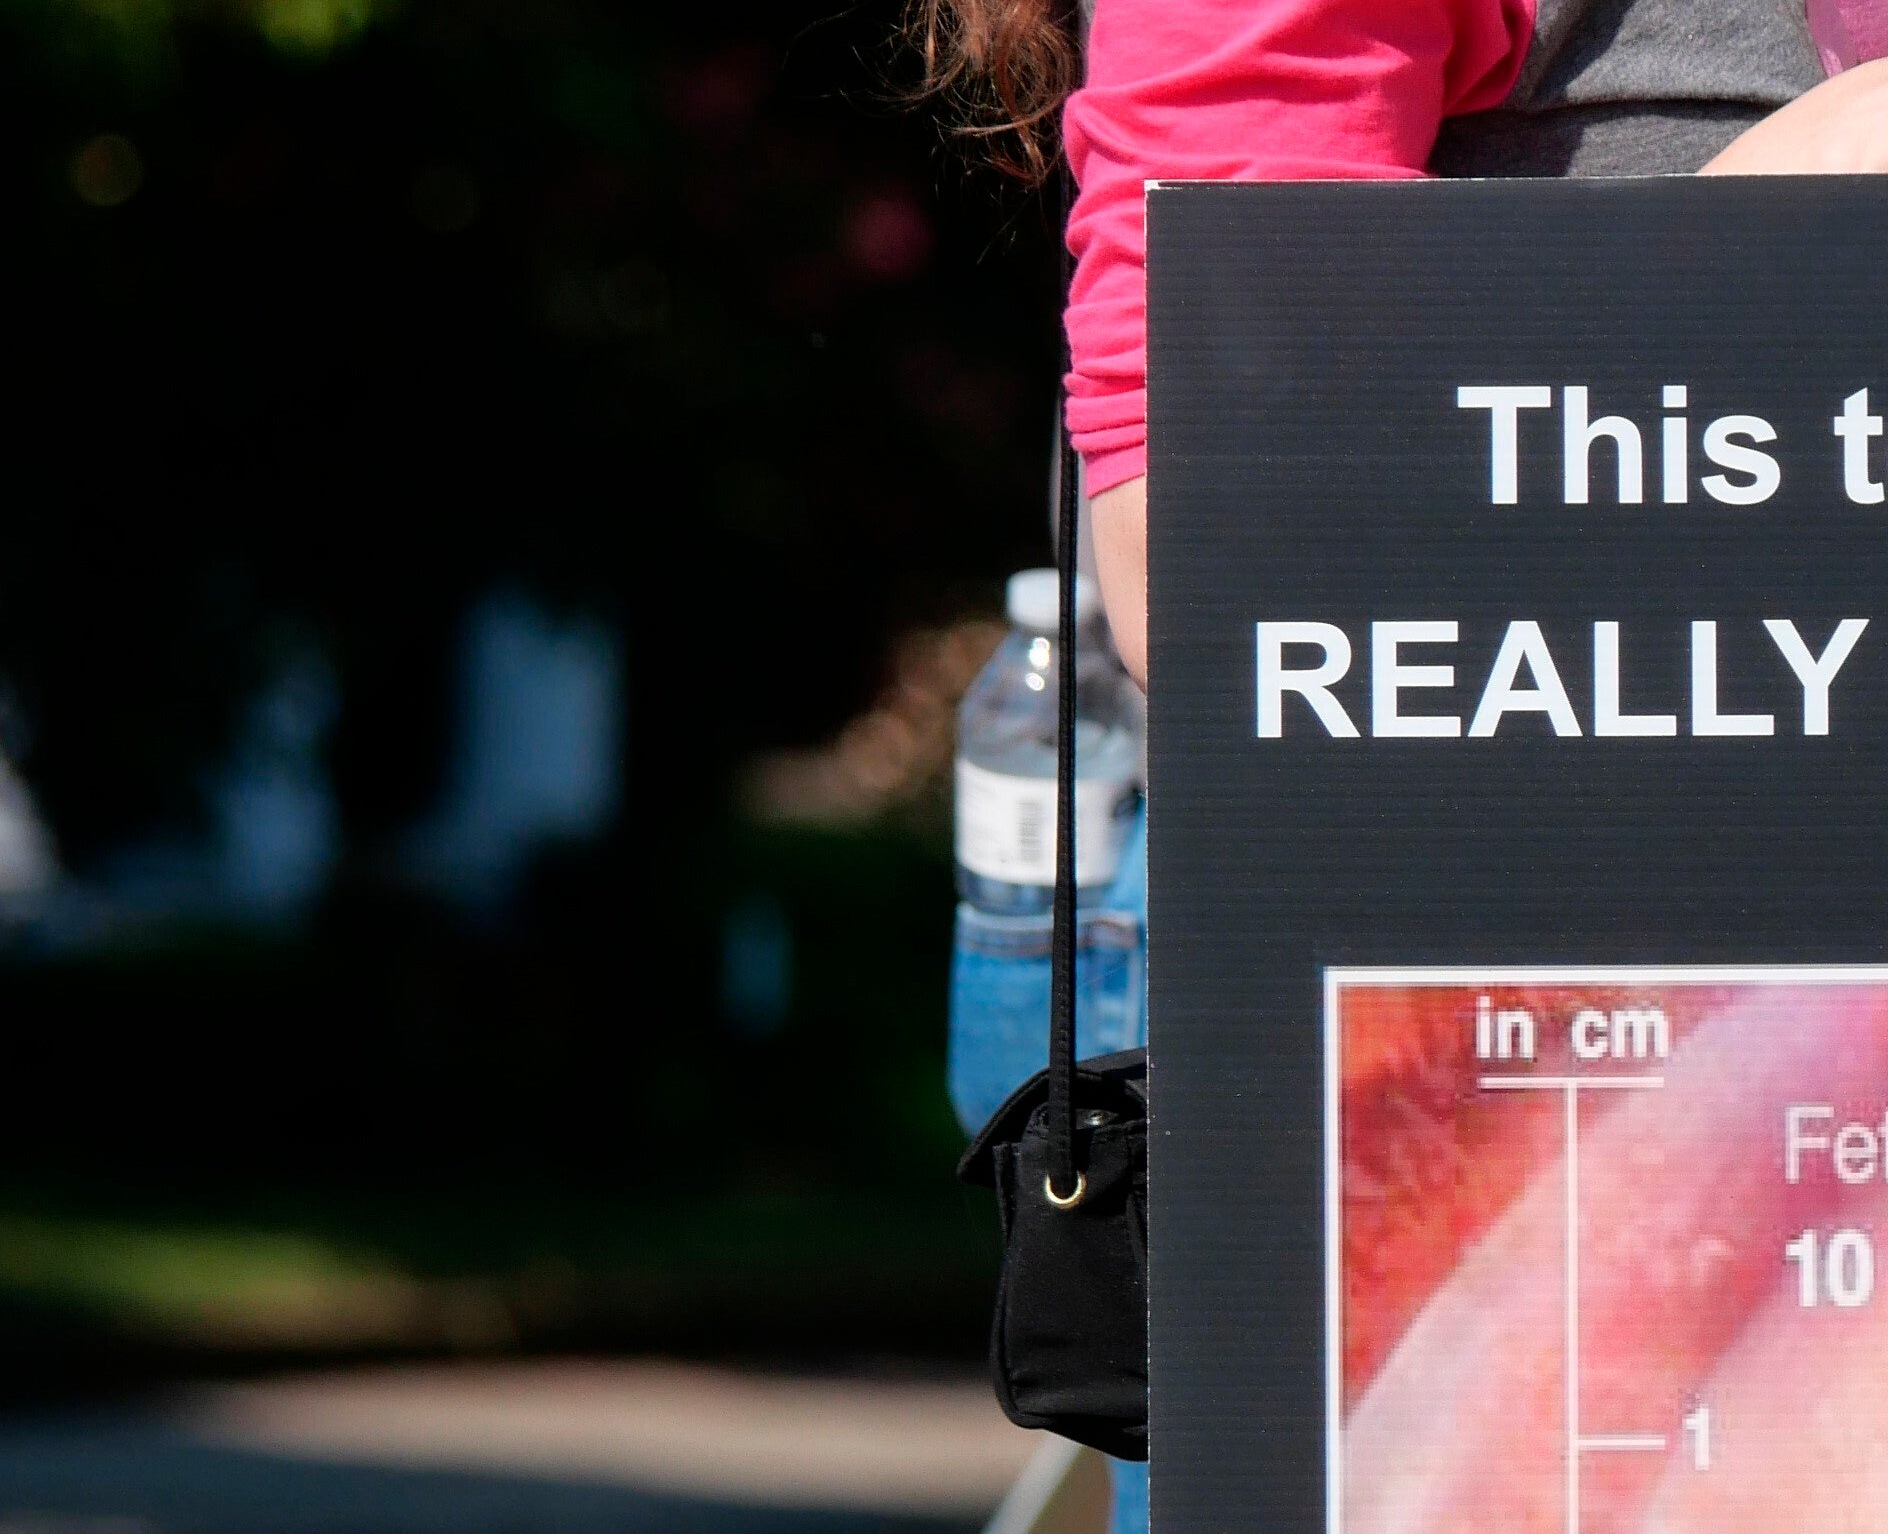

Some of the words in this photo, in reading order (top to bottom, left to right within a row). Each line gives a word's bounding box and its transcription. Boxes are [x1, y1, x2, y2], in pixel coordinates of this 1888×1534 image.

[1457, 385, 1781, 505] This
[1257, 619, 1869, 738] REALLY
[1476, 995, 1535, 1059] in
[1572, 1010, 1669, 1059] cm
[1785, 1229, 1874, 1308] 10
[1683, 1403, 1710, 1471] 1
